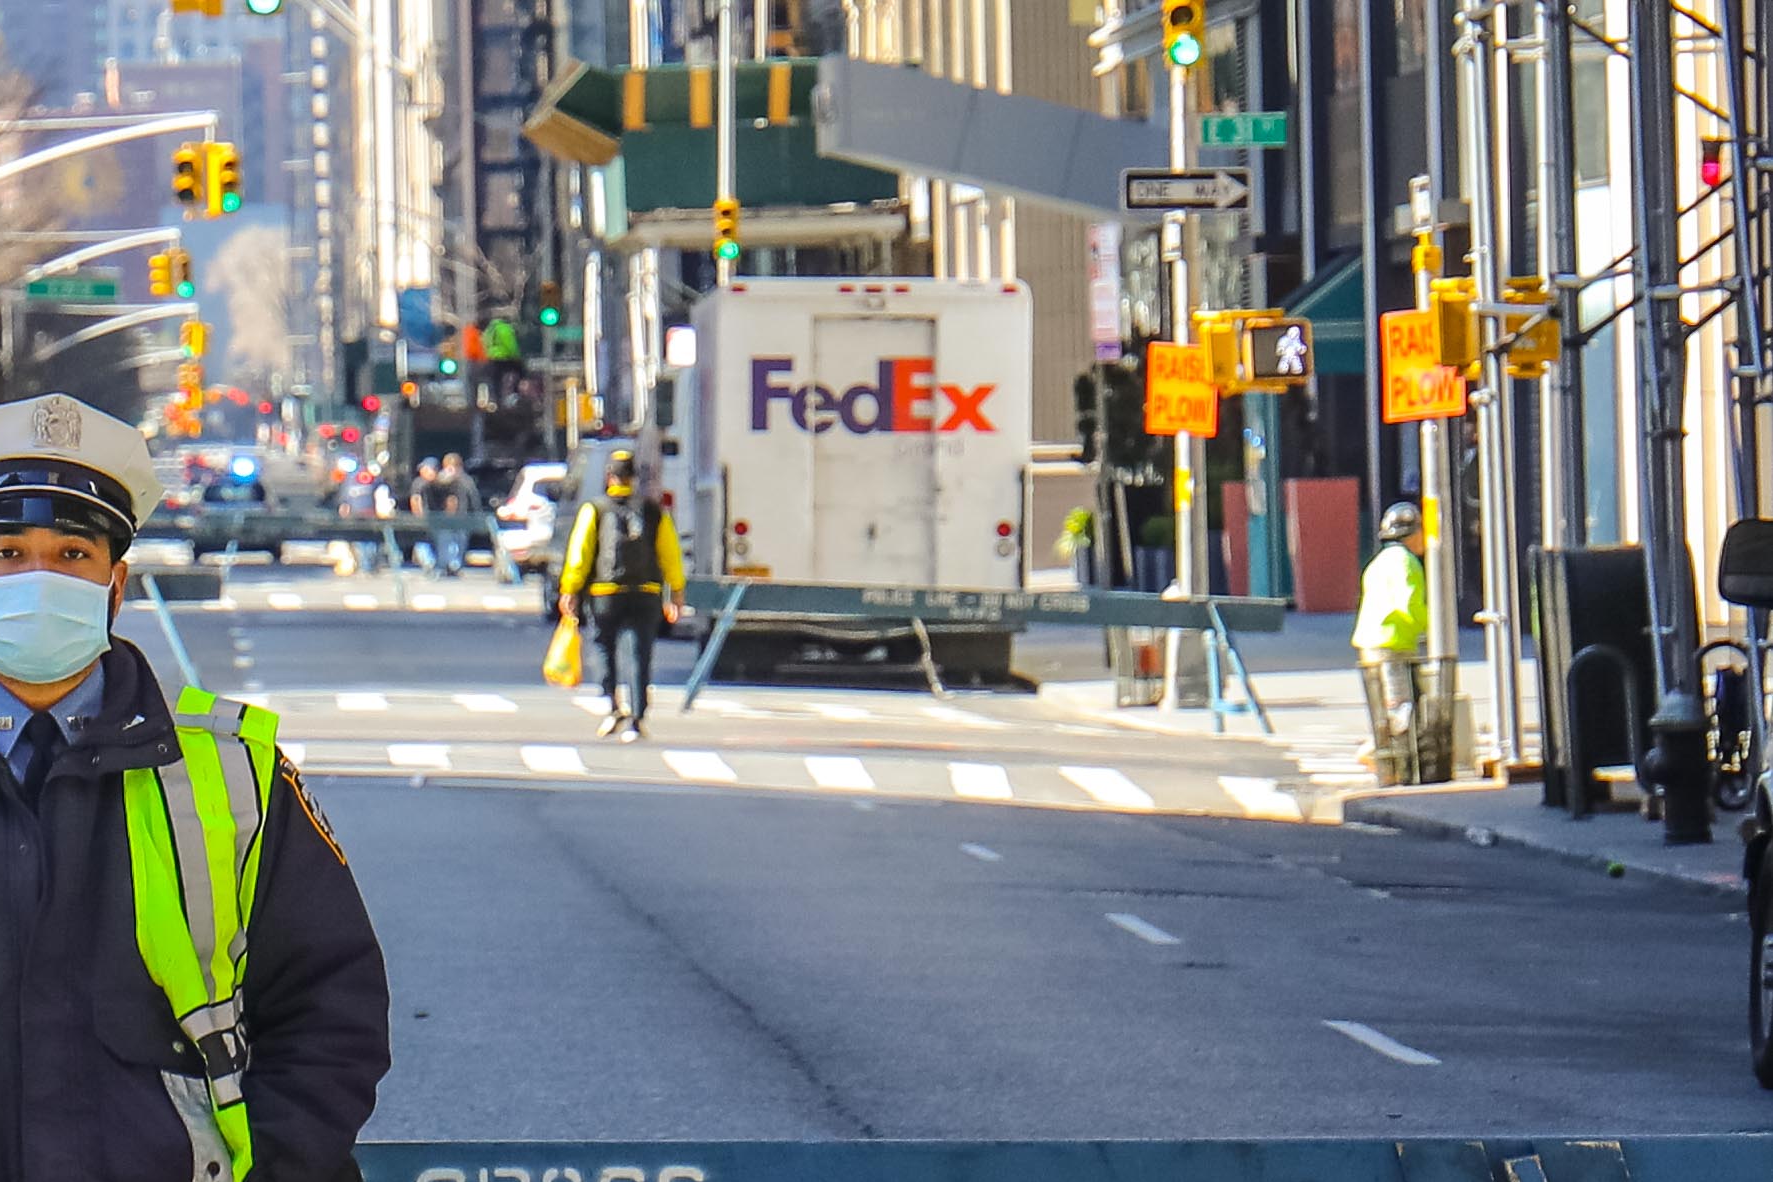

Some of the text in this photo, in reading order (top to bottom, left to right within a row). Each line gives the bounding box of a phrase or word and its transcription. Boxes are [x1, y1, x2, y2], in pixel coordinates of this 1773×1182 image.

[1138, 181, 1230, 200] ONE WAY
[1389, 322, 1435, 358] RAI
[751, 358, 996, 434] FedEx
[1390, 372, 1456, 407] PLOW
[1154, 394, 1208, 424] PLOW
